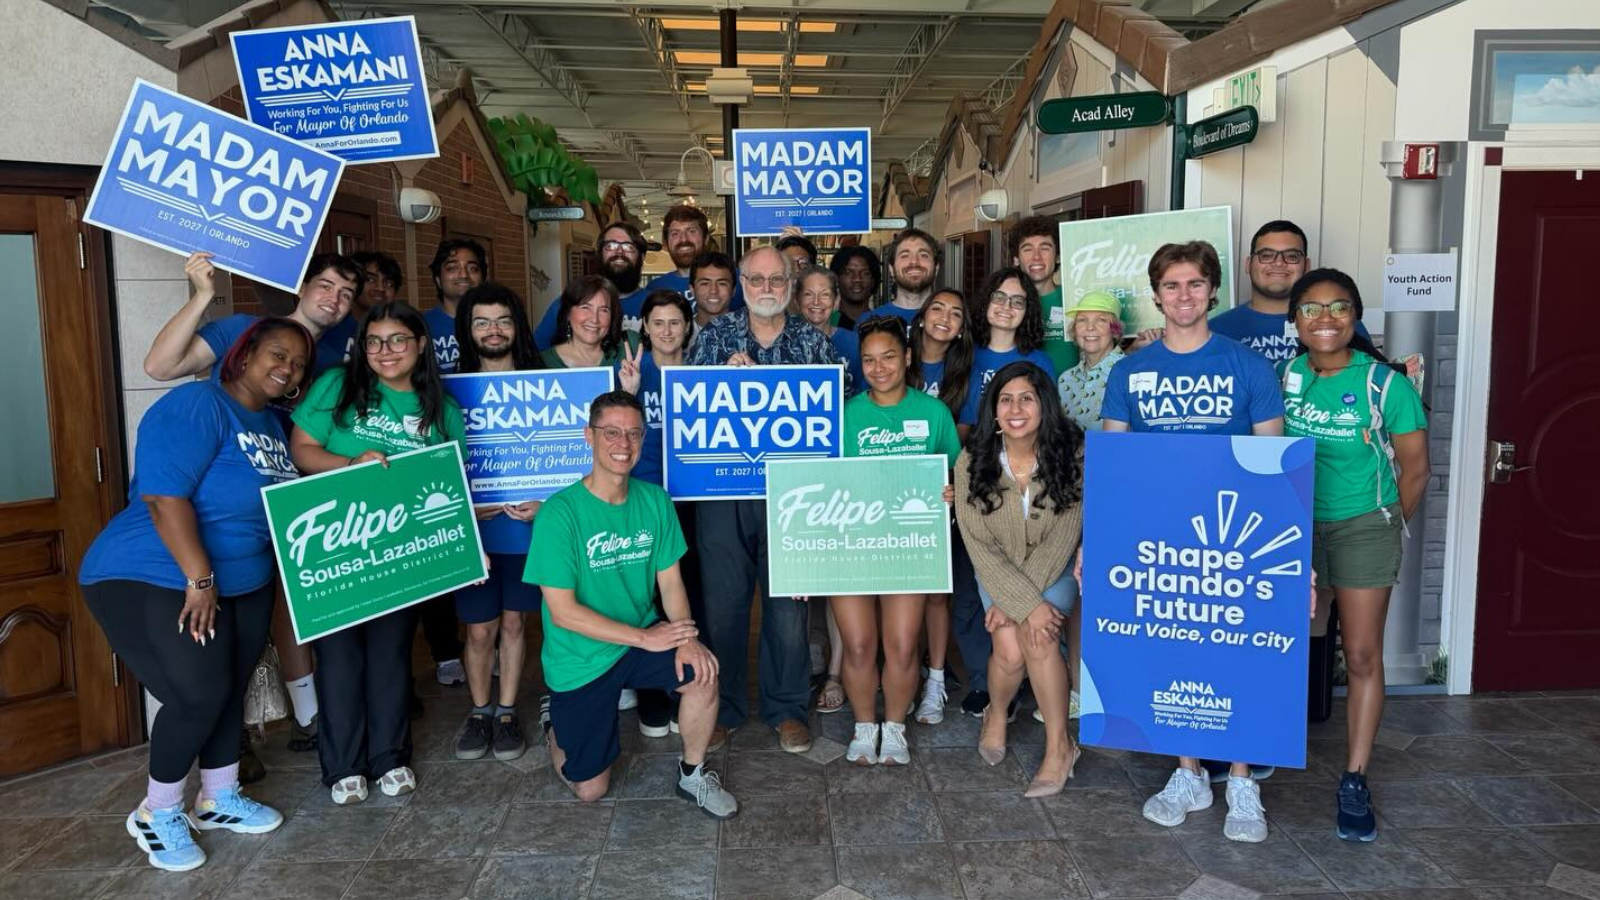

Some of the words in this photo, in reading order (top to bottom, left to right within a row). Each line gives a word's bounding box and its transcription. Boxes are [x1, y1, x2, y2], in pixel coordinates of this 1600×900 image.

[284, 31, 371, 62] ANNA
[256, 55, 409, 92] ESKAMANI
[267, 108, 306, 120] Working
[306, 106, 321, 116] For
[322, 105, 342, 115] You,
[343, 101, 379, 114] Fighting
[380, 100, 395, 109] For
[396, 98, 409, 108] Us
[273, 121, 293, 134] For
[295, 119, 337, 135] Mayor
[340, 115, 357, 132] Of
[359, 111, 409, 129] Orlando
[1071, 106, 1101, 122] Acad
[1104, 104, 1135, 121] Alley
[1193, 126, 1219, 148] Boulevard
[1220, 123, 1228, 139] of
[1227, 120, 1251, 137] Dreams
[133, 100, 329, 201] MADAM
[741, 140, 863, 167] MADAM
[118, 138, 313, 237] MAYOR
[743, 169, 863, 196] MAYOR
[157, 210, 176, 223] EST.
[178, 217, 202, 232] 2027
[208, 228, 250, 249] ORLANDO
[1070, 239, 1150, 286] Felip
[1387, 274, 1417, 284] Youth
[1419, 273, 1452, 284] Action
[1406, 287, 1432, 296] Fund
[1250, 334, 1299, 348] ANNA
[480, 378, 567, 404] ANNA
[672, 380, 833, 413] MADAM
[462, 402, 591, 431] ESKAMAN
[1138, 395, 1234, 419] MAYOR
[1283, 397, 1330, 425] Felipe
[672, 416, 833, 449] MAYOR
[857, 426, 906, 448] Felipe
[467, 447, 493, 457] rking
[494, 446, 509, 455] For
[510, 446, 529, 455] You,
[531, 443, 567, 454] Fighting
[568, 442, 583, 450] For
[465, 463, 478, 472] or
[480, 458, 522, 474] Mayor
[525, 456, 542, 472] Of
[544, 454, 594, 469] Orlando
[715, 467, 731, 476] EST.
[732, 467, 751, 476] 2027
[777, 483, 886, 533] Felipe
[285, 499, 409, 568] Felipe
[586, 530, 632, 559] Felipe
[780, 532, 938, 551] Sousa-Lazaballet
[299, 522, 467, 588] Sousa-Lazaballet
[1138, 540, 1245, 577] Shape
[306, 581, 354, 602] Florida
[360, 567, 397, 584] House
[402, 550, 451, 570] District
[455, 544, 465, 553] 42
[1109, 565, 1274, 600] Orlando's
[1136, 593, 1245, 626] Future
[1096, 617, 1141, 636] Your
[1145, 623, 1205, 644] Voice,
[1210, 628, 1248, 646] Our
[1252, 630, 1295, 654] City
[1153, 690, 1232, 711] ESKAMANI
[1169, 679, 1215, 696] ANNA
